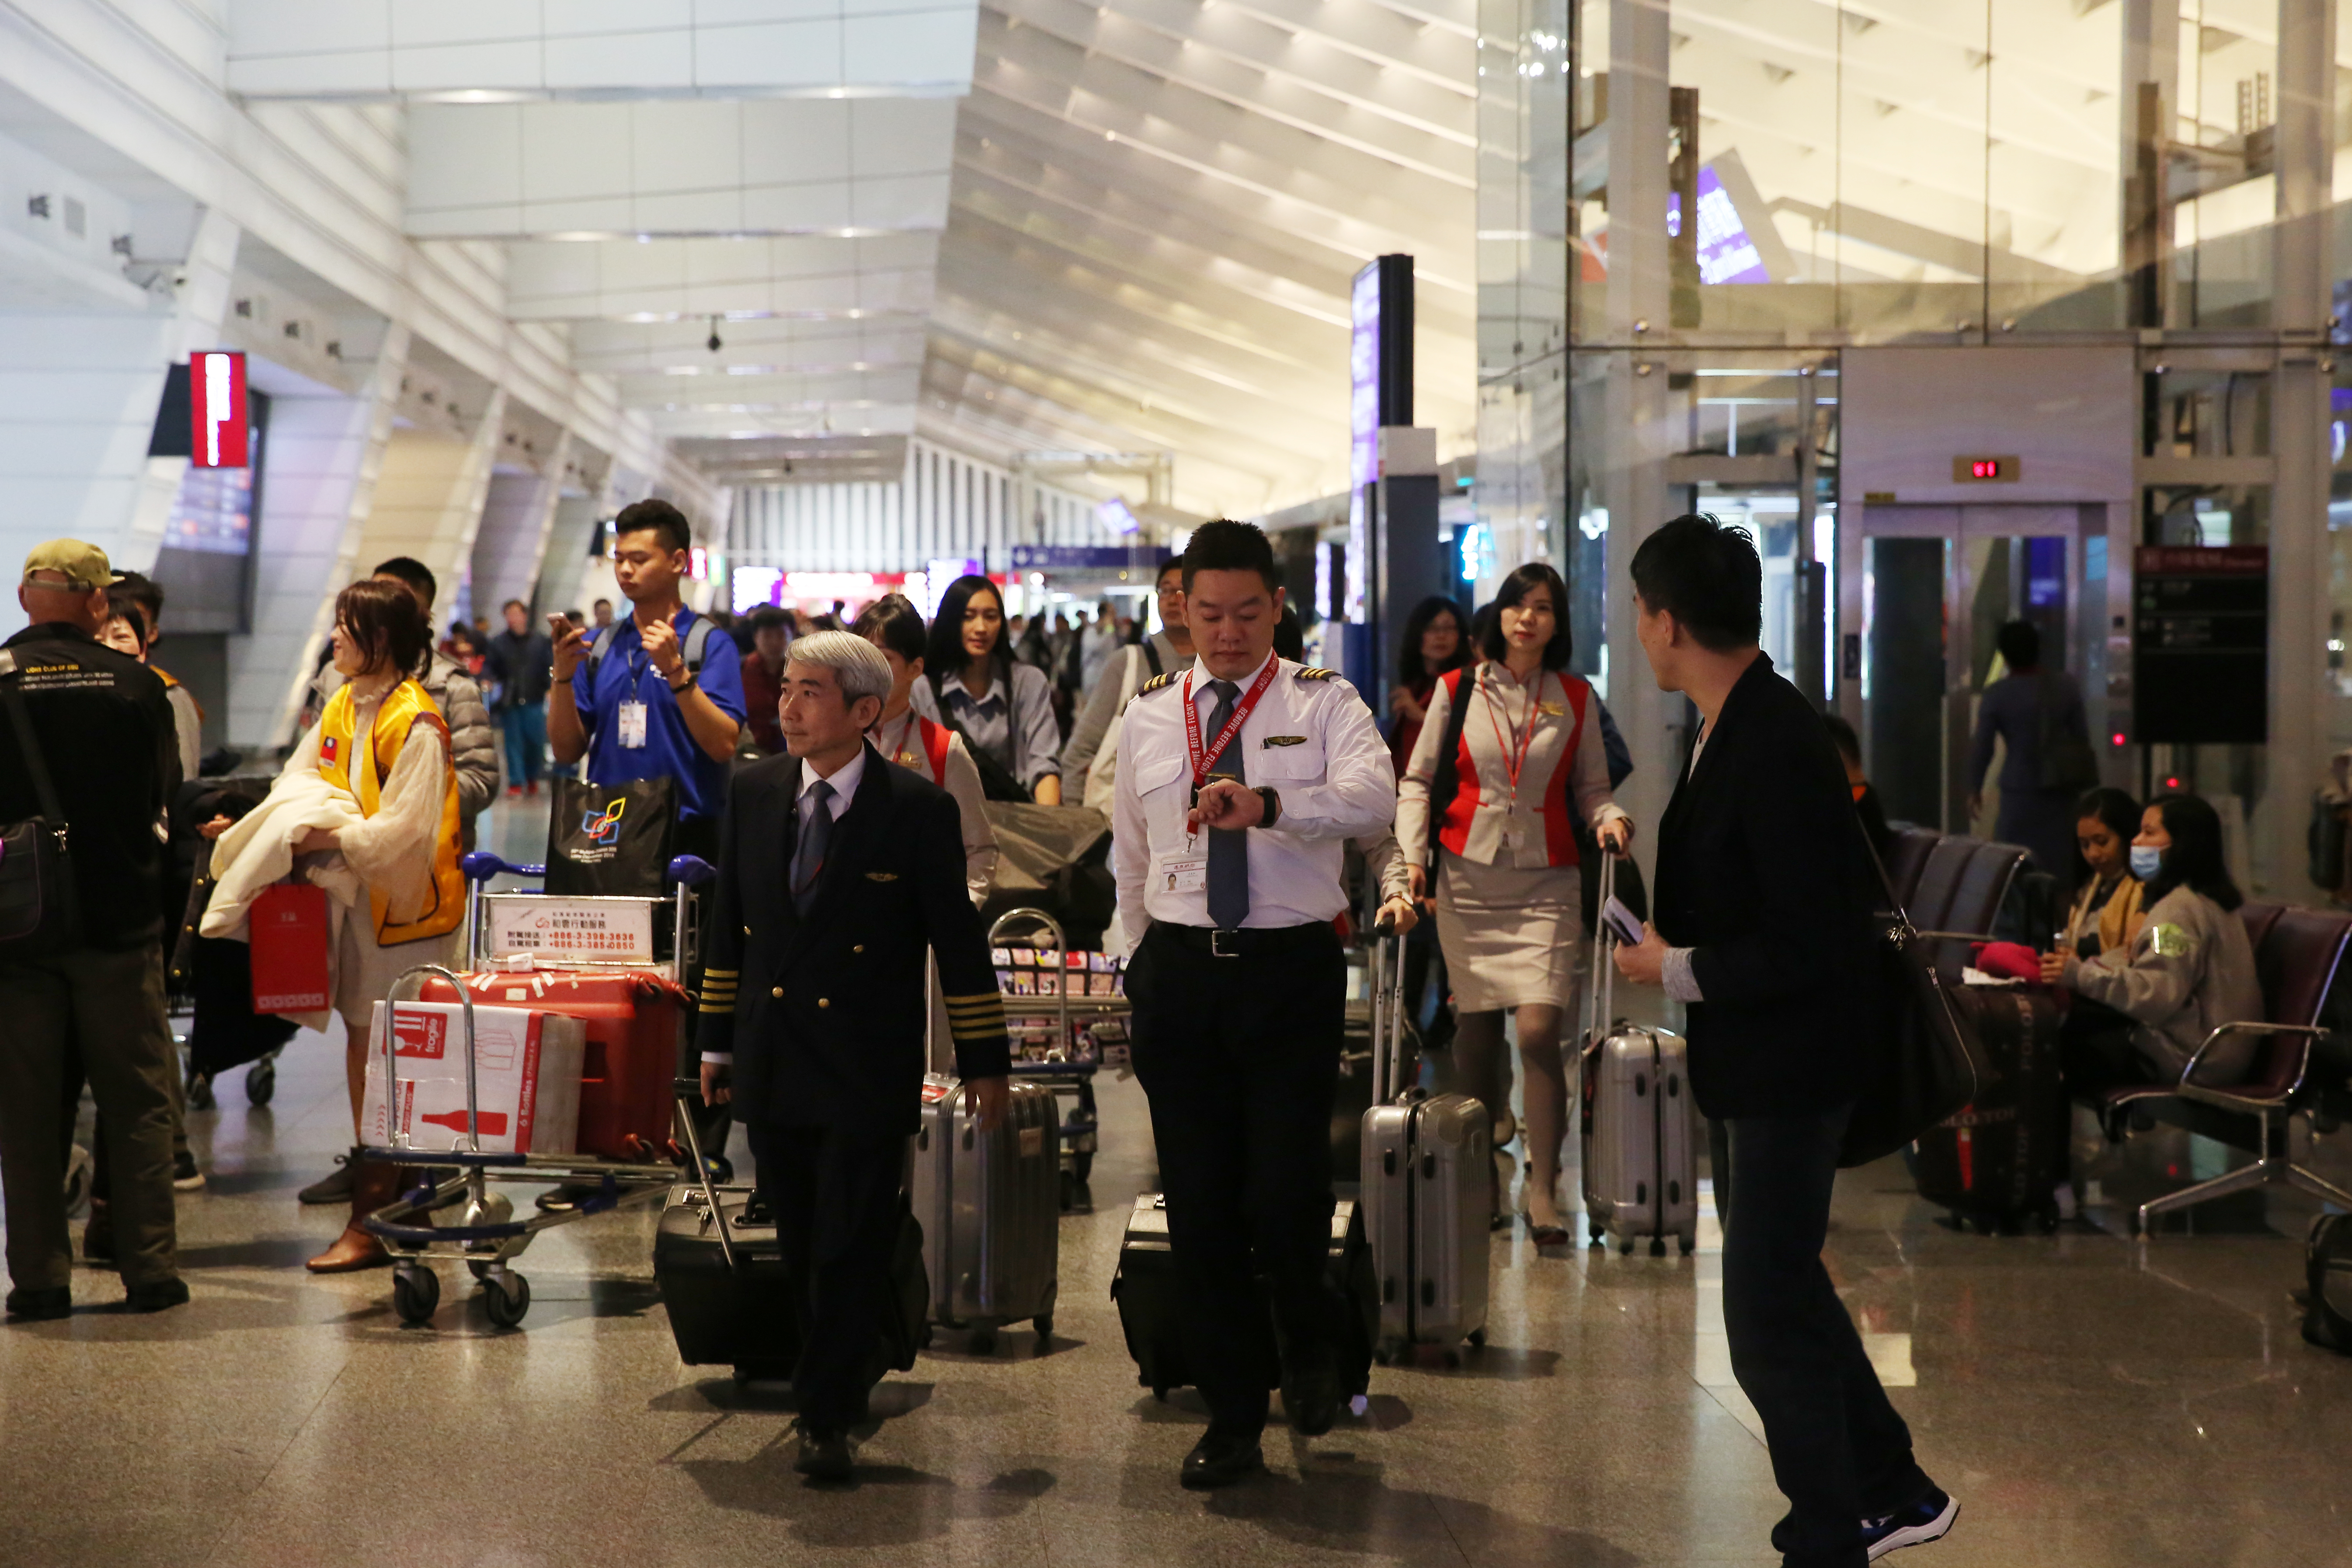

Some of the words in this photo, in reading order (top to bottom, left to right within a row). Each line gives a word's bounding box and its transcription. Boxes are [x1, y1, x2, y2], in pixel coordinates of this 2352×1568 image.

[1257, 672, 1272, 691] FLIGHT
[1186, 703, 1195, 724] FLIGHT
[1228, 707, 1248, 732] REMOVE
[1189, 725, 1199, 748] BEFORE
[1211, 731, 1232, 754] BEFORE
[1199, 752, 1215, 775] FLIGHT
[520, 1079, 532, 1116] Bottles
[518, 1119, 528, 1127] 6
